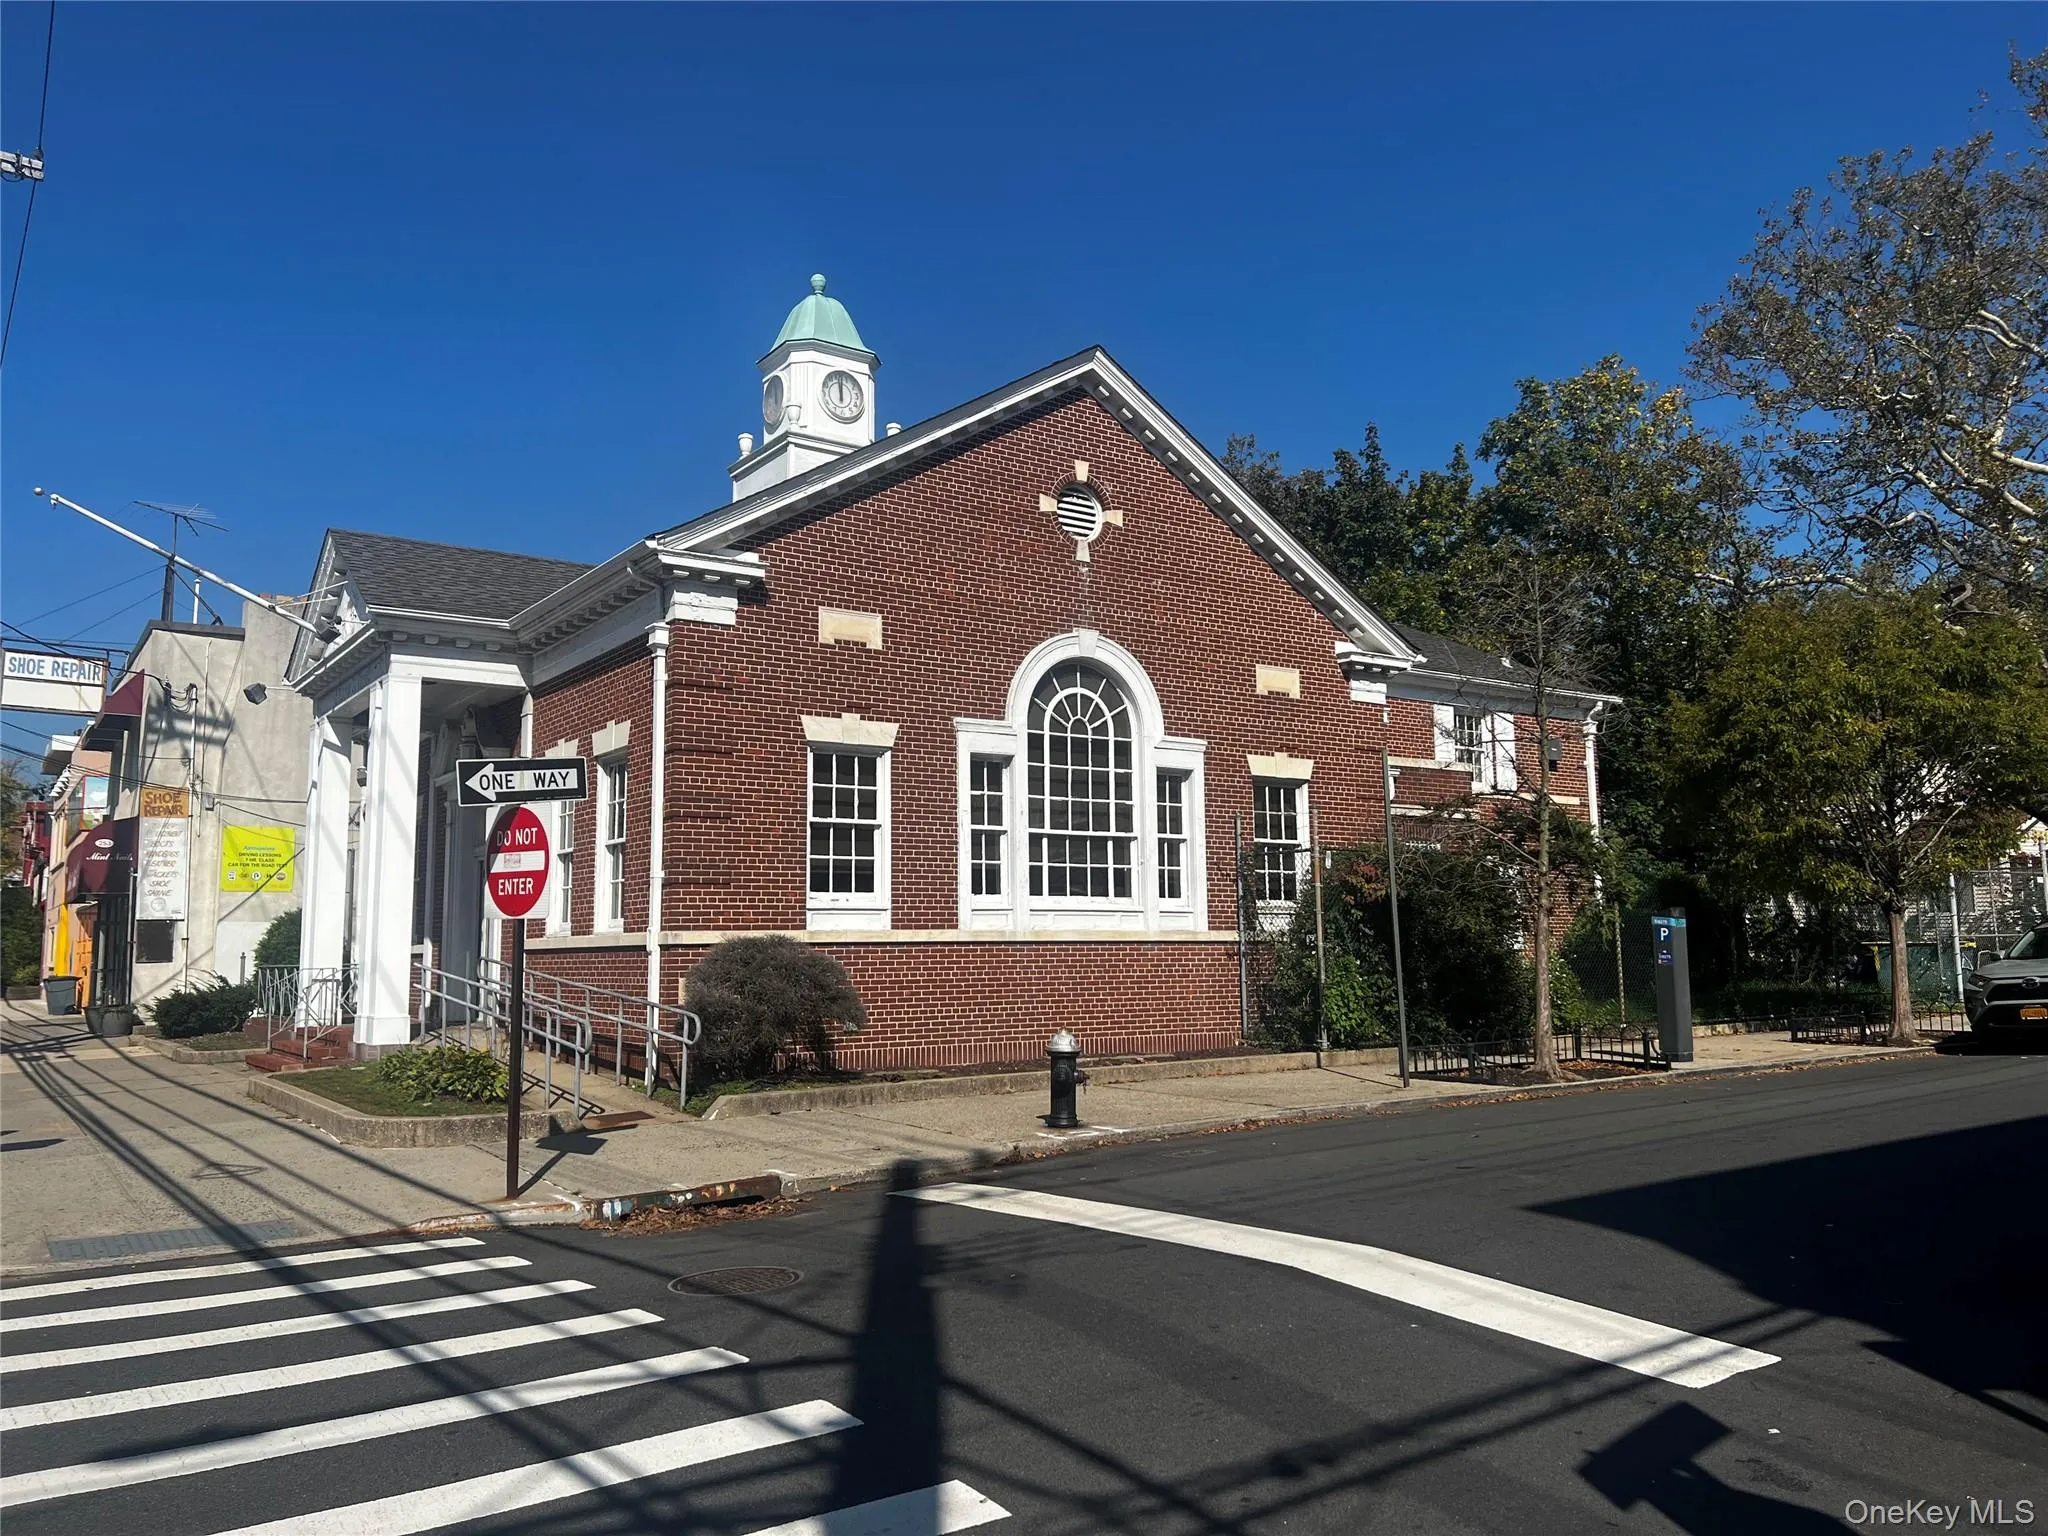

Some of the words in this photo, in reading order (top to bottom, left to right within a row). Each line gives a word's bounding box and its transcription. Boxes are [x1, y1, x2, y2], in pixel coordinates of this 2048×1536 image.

[8, 657, 45, 675] SHOE
[51, 661, 100, 681] REPAIR
[479, 773, 516, 791] ONE
[533, 771, 570, 788] WAY
[144, 791, 182, 804] SHOE
[144, 804, 184, 817] REPAIR
[496, 830, 511, 846] DO
[515, 827, 538, 846] NOT
[86, 852, 110, 860] Mint
[498, 877, 534, 896] ENTER
[1660, 927, 1669, 941] P
